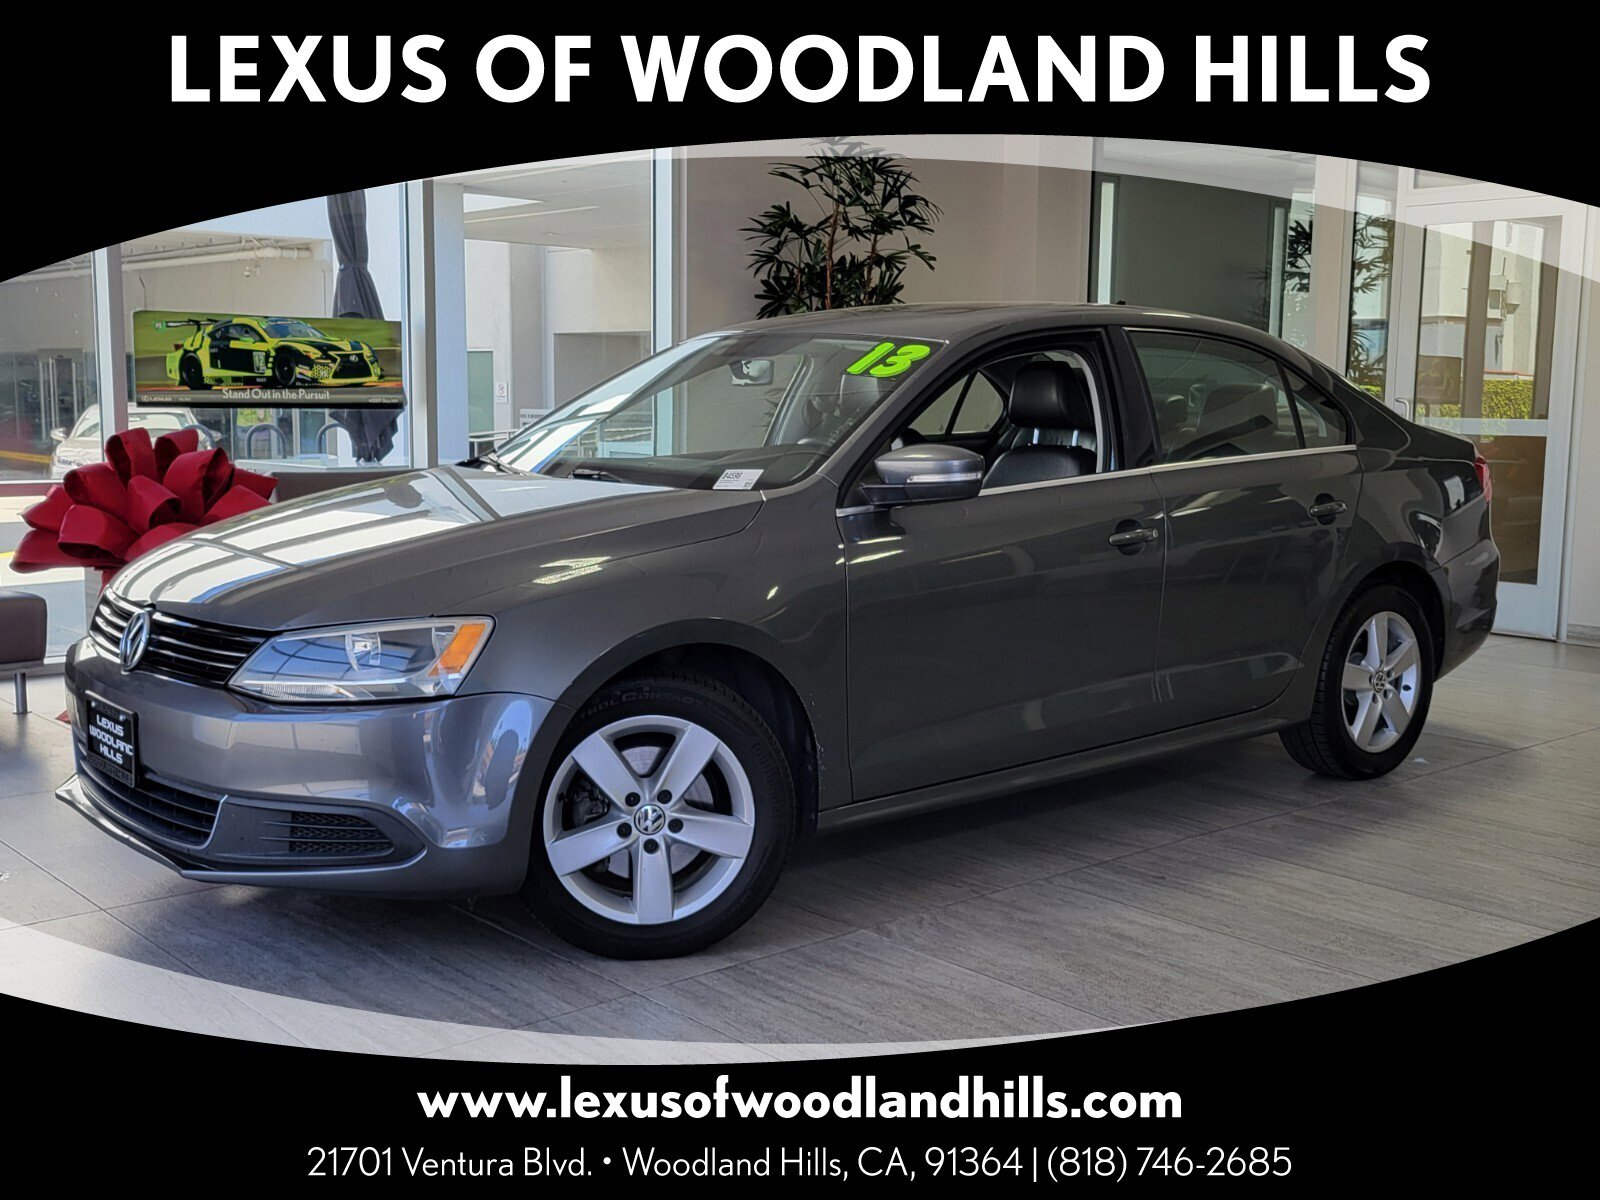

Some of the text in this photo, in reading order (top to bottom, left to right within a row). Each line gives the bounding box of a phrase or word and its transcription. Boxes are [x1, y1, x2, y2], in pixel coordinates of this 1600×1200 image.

[846, 342, 931, 378] 13
[222, 388, 330, 400] Stand Out in the Pursuit
[96, 713, 124, 737] LEXUS
[100, 743, 123, 764] HILLS
